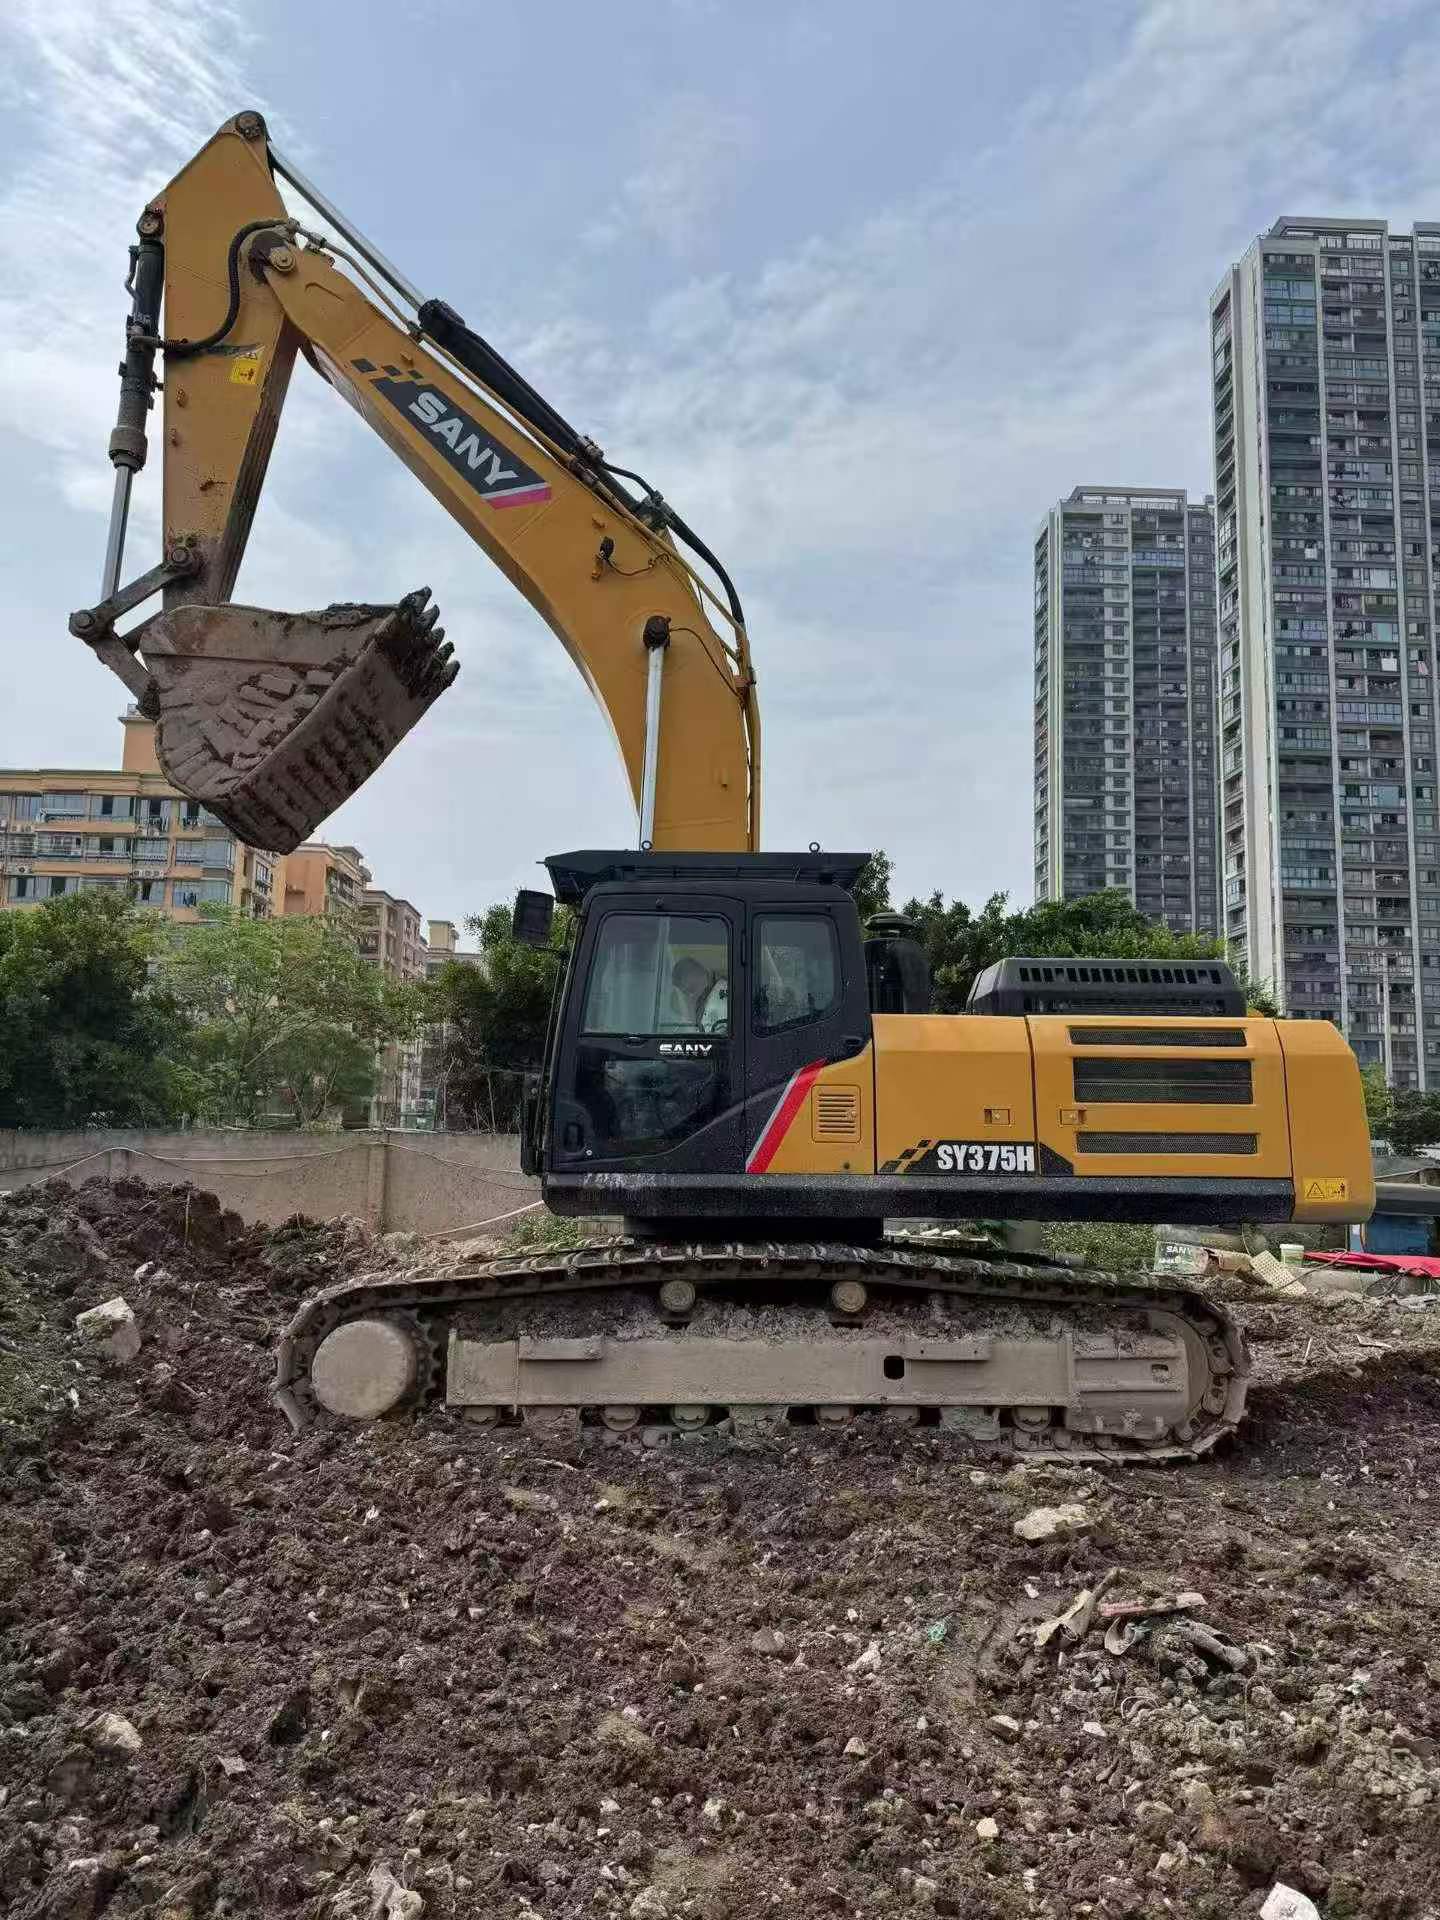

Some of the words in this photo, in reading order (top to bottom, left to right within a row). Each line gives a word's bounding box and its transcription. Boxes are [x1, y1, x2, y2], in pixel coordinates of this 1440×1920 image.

[408, 391, 519, 486] SANY
[659, 1043, 713, 1052] SANY
[936, 1144, 1035, 1172] SY375H
